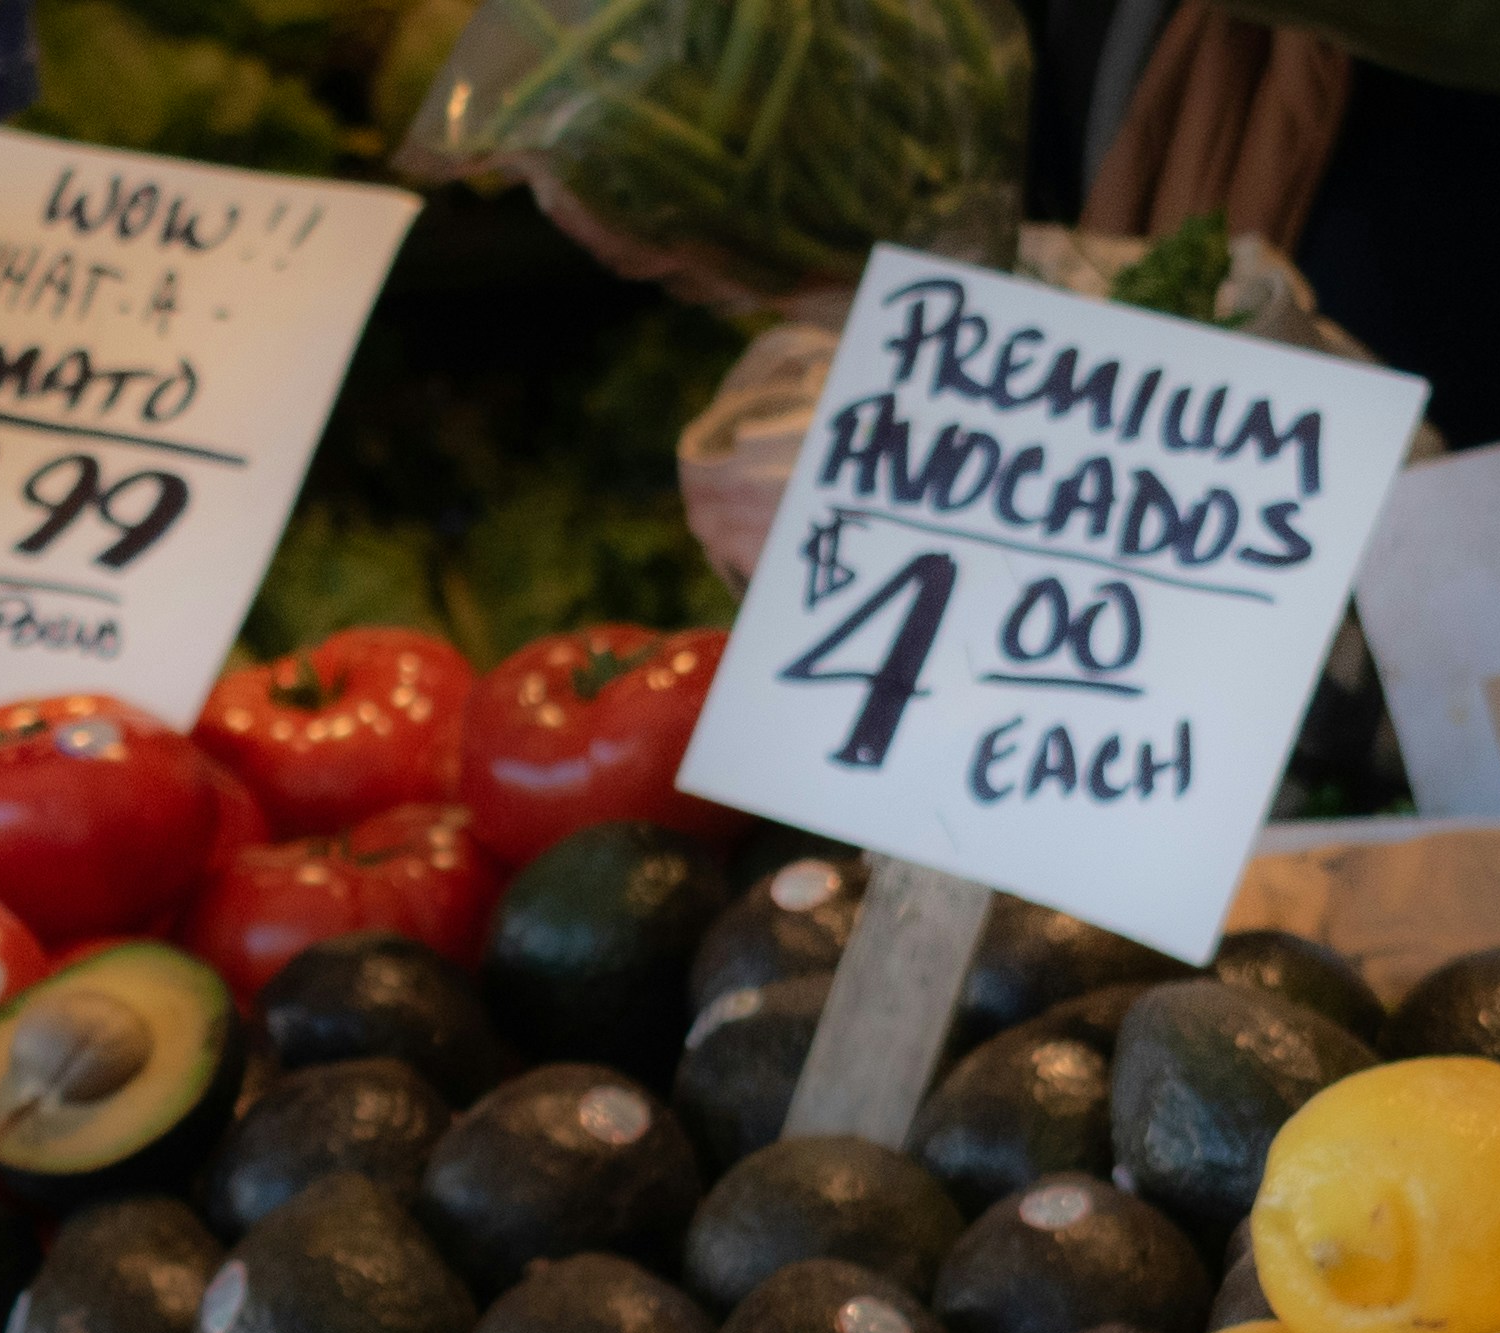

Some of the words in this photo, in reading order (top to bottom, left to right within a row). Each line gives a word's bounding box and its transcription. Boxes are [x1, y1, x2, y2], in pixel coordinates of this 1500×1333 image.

[881, 277, 1322, 496] PREMIUM
[817, 392, 1316, 570] AVOCADOS
[965, 716, 1194, 804] EACH
